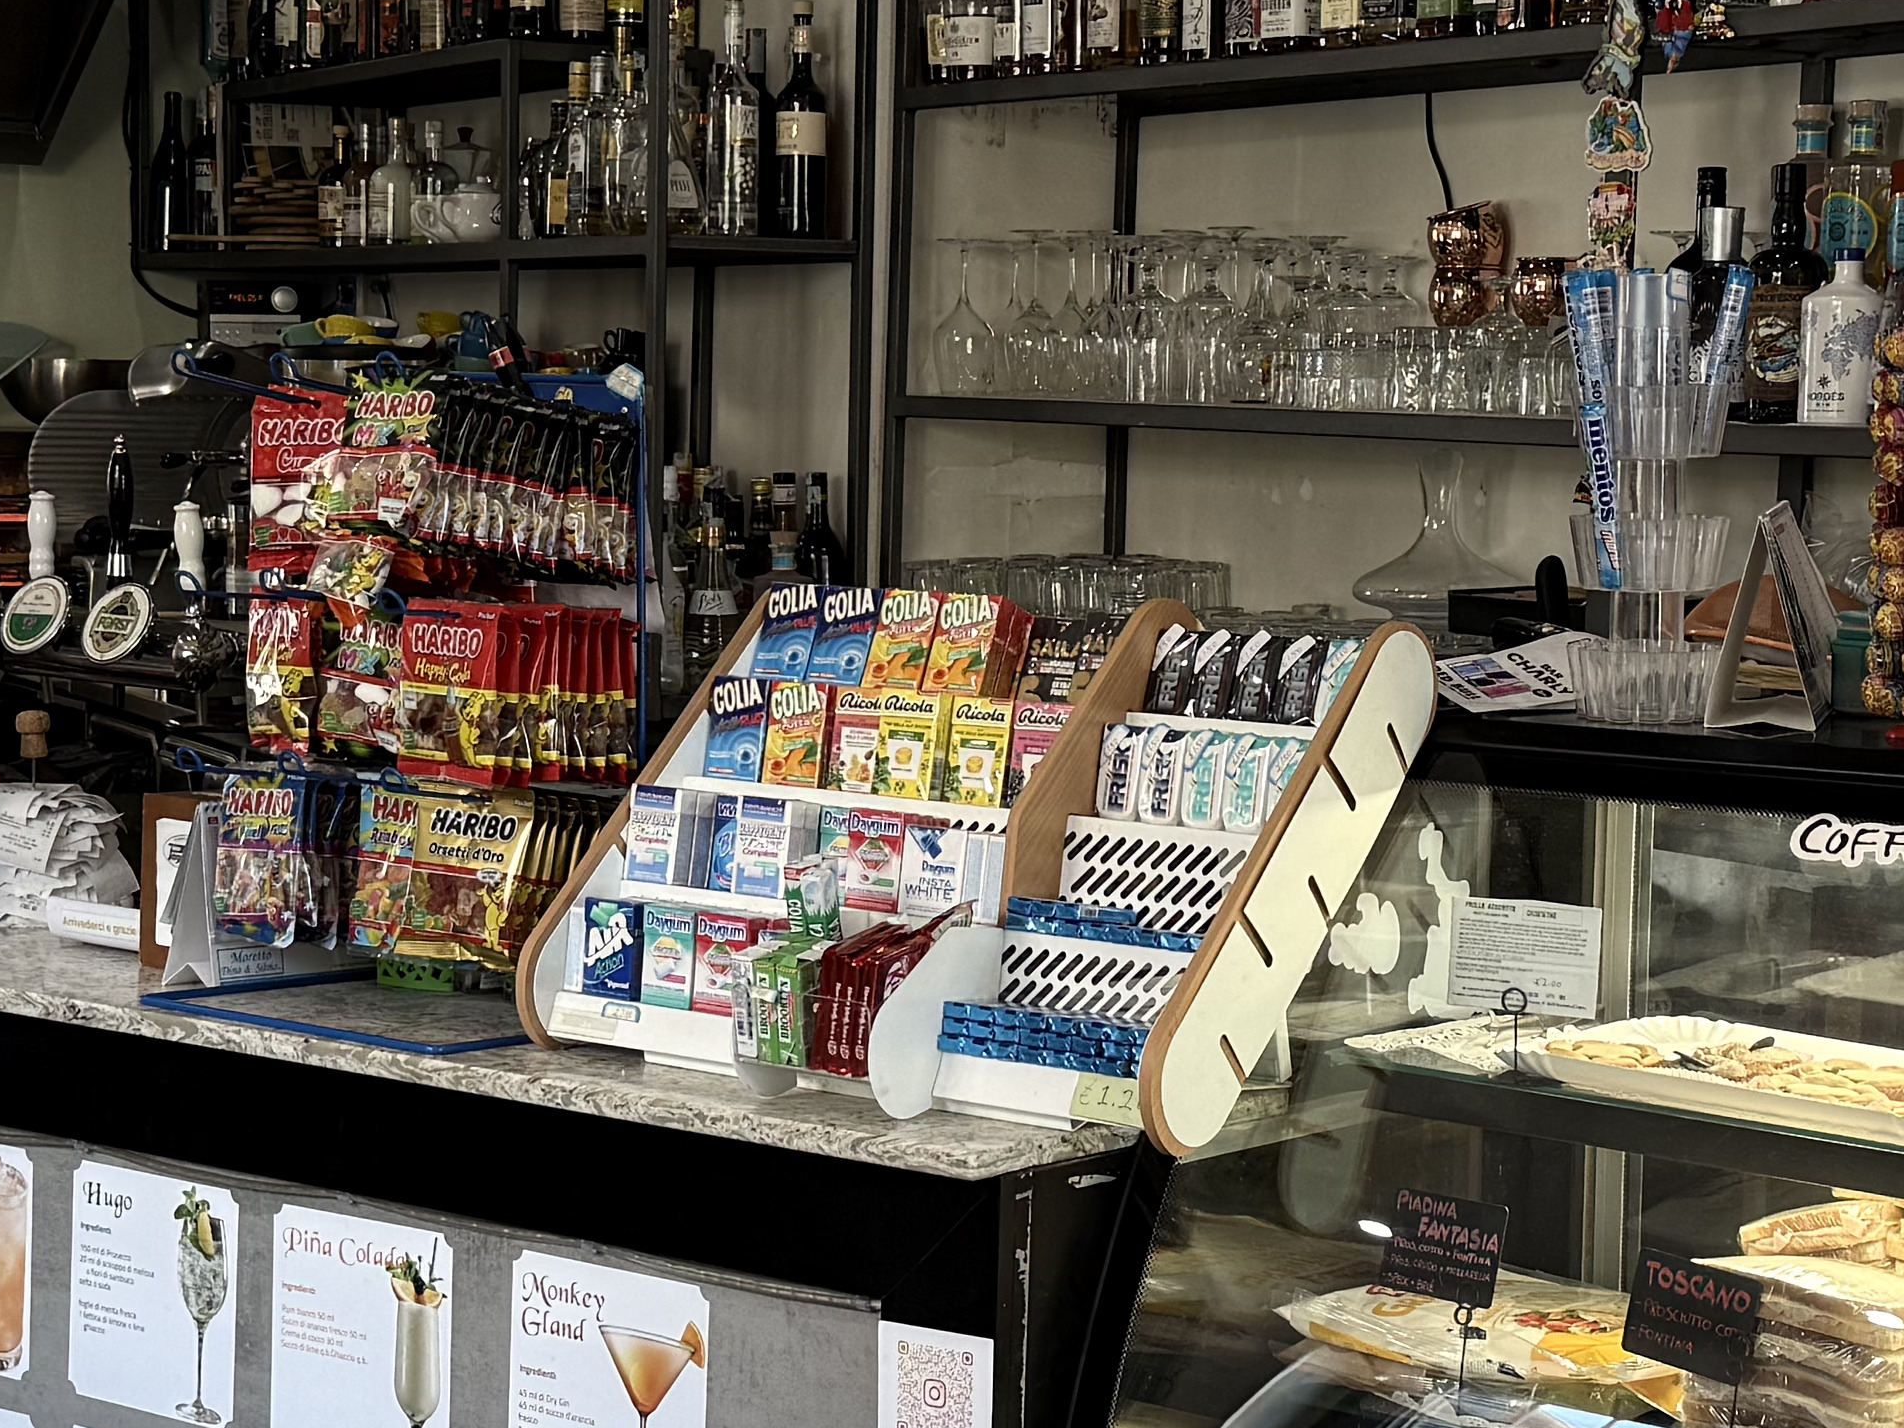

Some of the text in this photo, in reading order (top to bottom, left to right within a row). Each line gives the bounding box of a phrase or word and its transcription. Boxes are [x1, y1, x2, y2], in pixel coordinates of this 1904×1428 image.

[354, 391, 435, 419] HARIBO
[353, 424, 396, 445] MIX
[1587, 418, 1616, 524] mentos
[768, 584, 817, 619] GOLIA
[824, 588, 875, 622] GOLIA
[881, 591, 932, 623] GOLIA
[412, 624, 484, 658] HARIBO
[1506, 652, 1574, 695] CHARLY
[885, 695, 934, 714] Ricola
[956, 704, 1005, 723] Ricola
[1108, 744, 1130, 811] FRISK
[430, 808, 518, 842] HARIBO
[850, 813, 899, 839] Daygum
[429, 843, 505, 864] Orsetti d'Oro
[922, 860, 955, 875] Daygum
[905, 884, 956, 901] WHITE
[918, 876, 952, 888] INSTA
[646, 909, 691, 933] Daygum
[586, 913, 634, 966] AIR
[595, 955, 624, 979] Action
[82, 1181, 133, 1213] Hugo
[1397, 1190, 1457, 1220] PIADINA
[283, 1227, 332, 1258] Piña
[1418, 1216, 1499, 1252] FANTASIA
[522, 1271, 605, 1326] Monkey
[1646, 1260, 1752, 1314] TOSCANO
[520, 1308, 585, 1343] Gland
